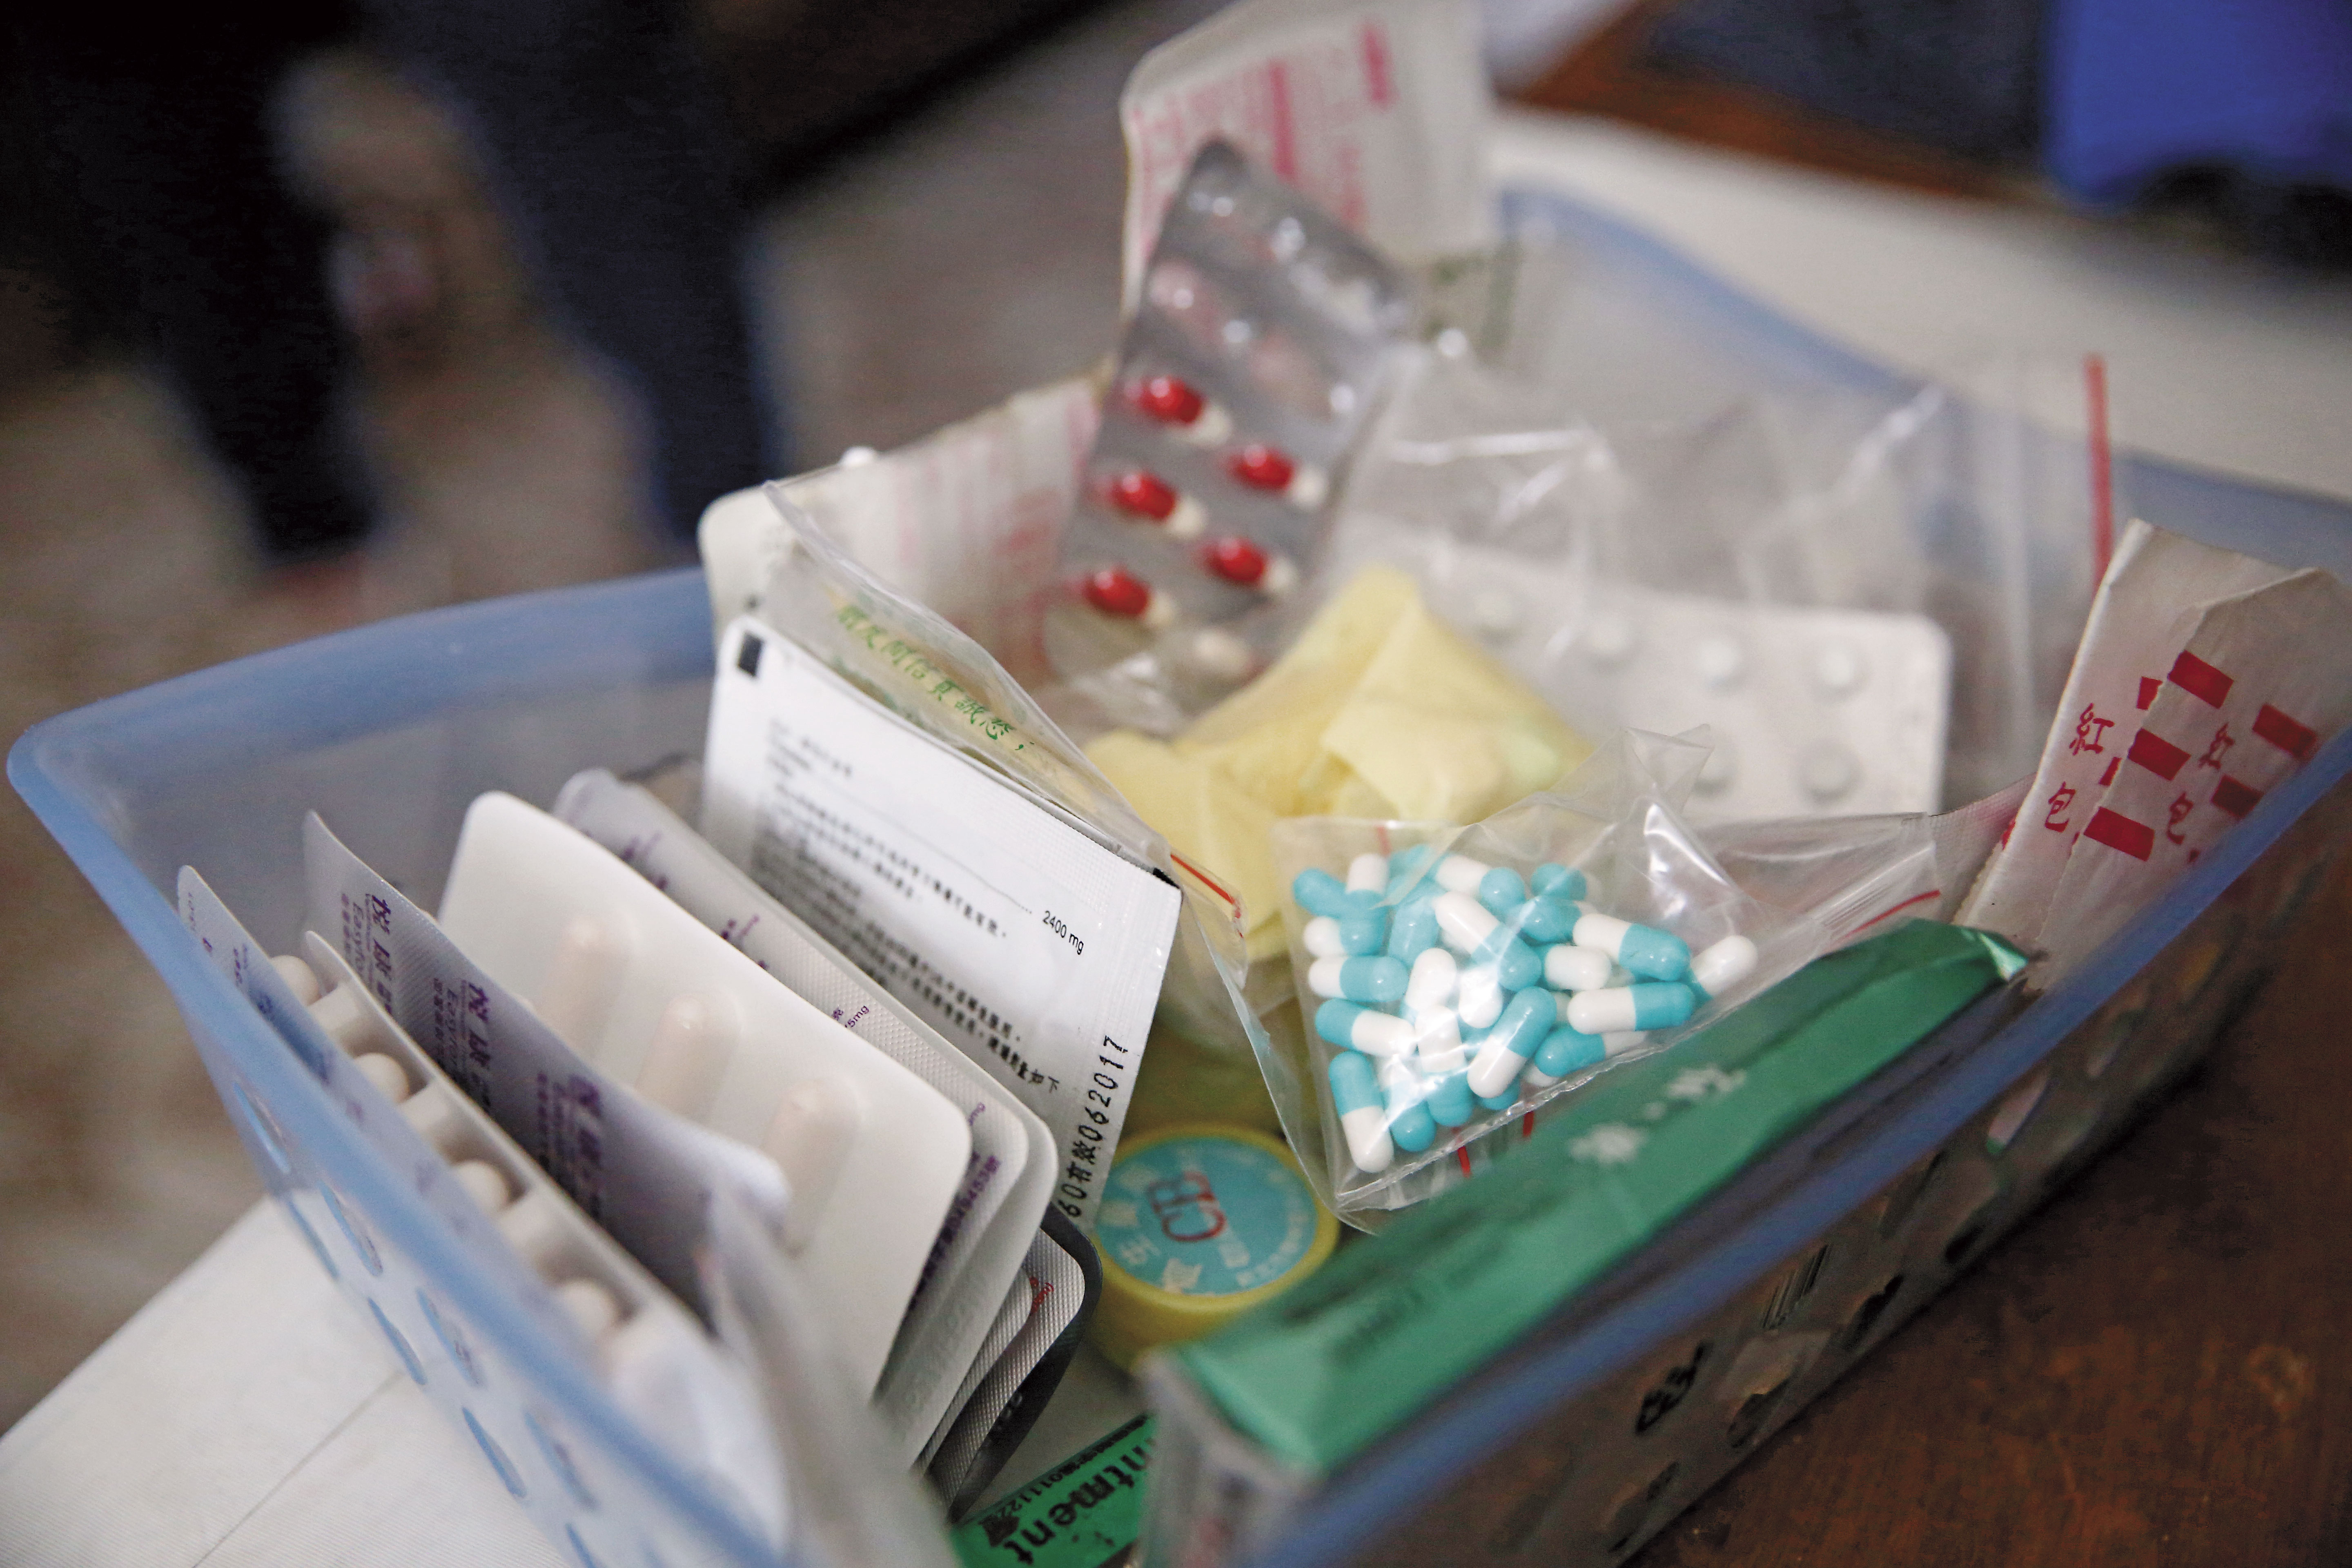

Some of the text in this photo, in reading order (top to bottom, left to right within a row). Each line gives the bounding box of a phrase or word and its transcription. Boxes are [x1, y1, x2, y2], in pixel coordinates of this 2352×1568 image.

[2045, 702, 2114, 833] 紅包
[1042, 910, 1084, 955] 2400 mg
